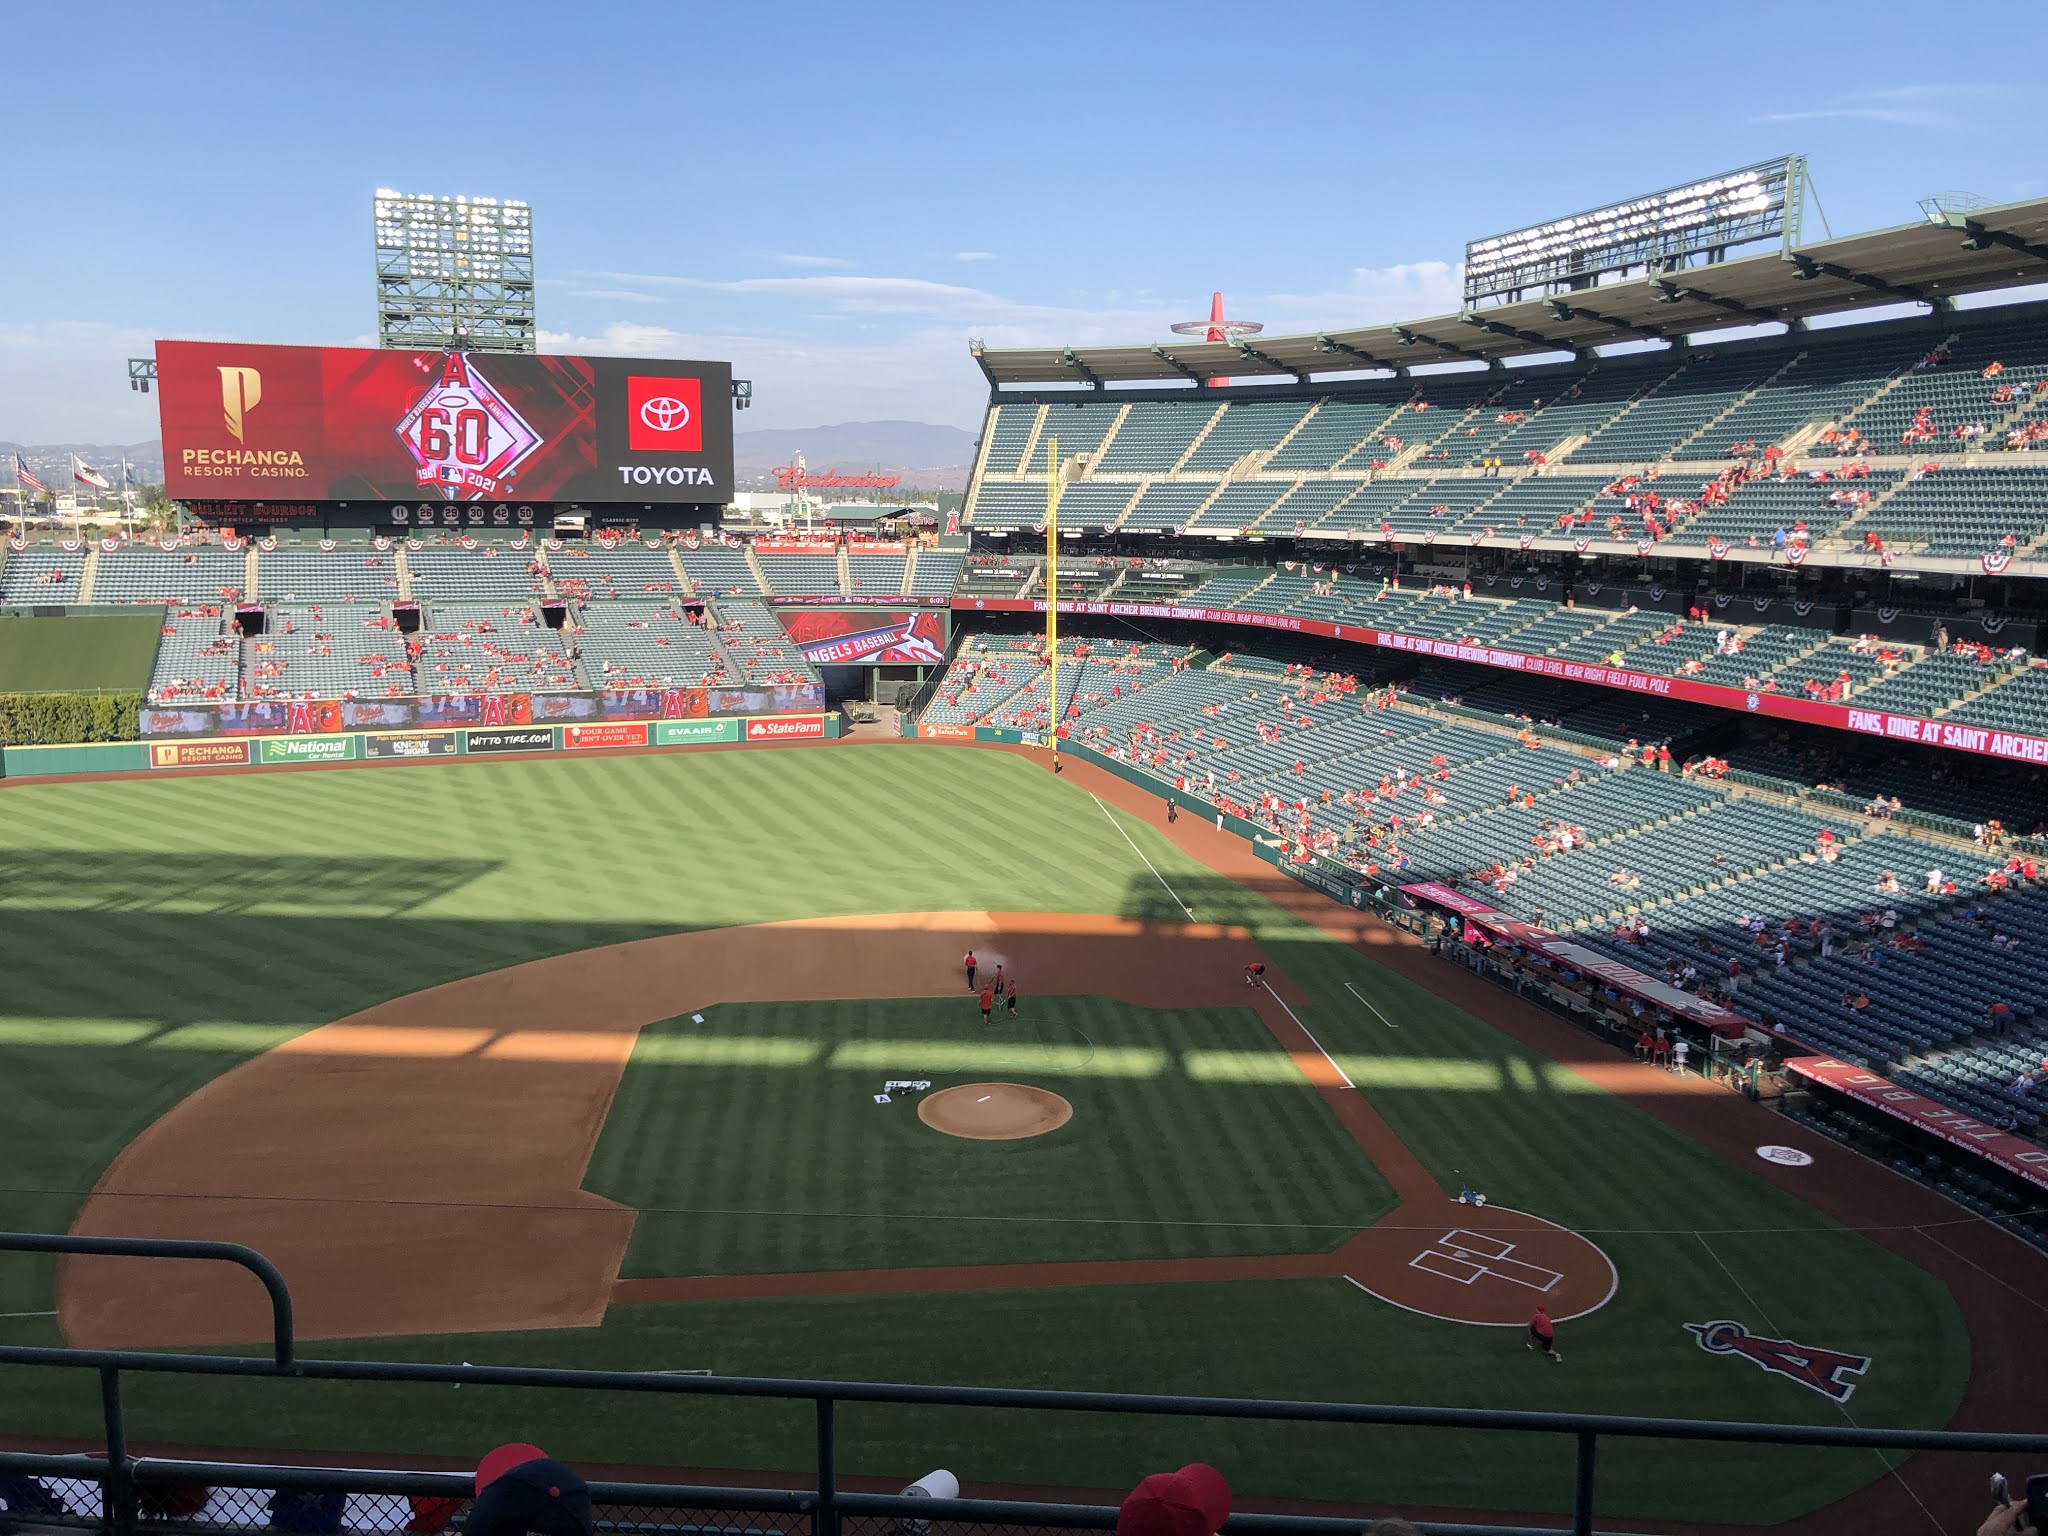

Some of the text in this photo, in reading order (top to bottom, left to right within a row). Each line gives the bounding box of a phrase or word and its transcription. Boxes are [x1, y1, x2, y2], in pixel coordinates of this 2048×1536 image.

[420, 408, 492, 465] 60
[183, 449, 304, 466] PECHANGA
[184, 467, 305, 477] RESORT CASINO
[618, 466, 714, 485] TOYOTA
[418, 468, 497, 493] 1961 2021
[772, 466, 902, 490] Budweiser
[396, 508, 404, 518] 11
[420, 508, 432, 518] 26
[445, 508, 457, 518] 29
[470, 508, 482, 518] 30
[495, 508, 507, 518] 42
[519, 508, 531, 518] 50
[1057, 603, 1074, 612] DINE
[1076, 603, 1086, 612] AT
[1088, 603, 1108, 613] SAINT
[1109, 604, 1138, 615] ARCHER
[1140, 606, 1170, 616] BREWING
[1171, 608, 1206, 619] COMPANY!
[1207, 610, 1221, 620] CLUB
[1221, 612, 1236, 622] LEVEL
[1237, 613, 1251, 623] NEAR
[1251, 615, 1266, 625] RIGHT
[1266, 616, 1278, 626] FIELD
[1278, 618, 1289, 628] FOUL
[1289, 619, 1301, 630] POLE
[854, 632, 899, 653] BASEBALL
[1377, 632, 1671, 694] FANS, DINE AT SAINT ARCHER BREWING COMPANY! CLUB LEVEL NEAR RIGHT FIELD FOUL POLE
[668, 727, 712, 736] EVA AIR
[1022, 731, 1040, 740] CONTACT
[1848, 710, 2048, 762] FANS, DINE AT SAINT ARCHE
[470, 733, 551, 747] NITTO TIRE.COM
[602, 734, 624, 742] OVER
[181, 746, 243, 756] PECHANGA
[287, 740, 347, 754] National
[404, 747, 430, 755] SIGNS
[322, 751, 345, 759] Rental
